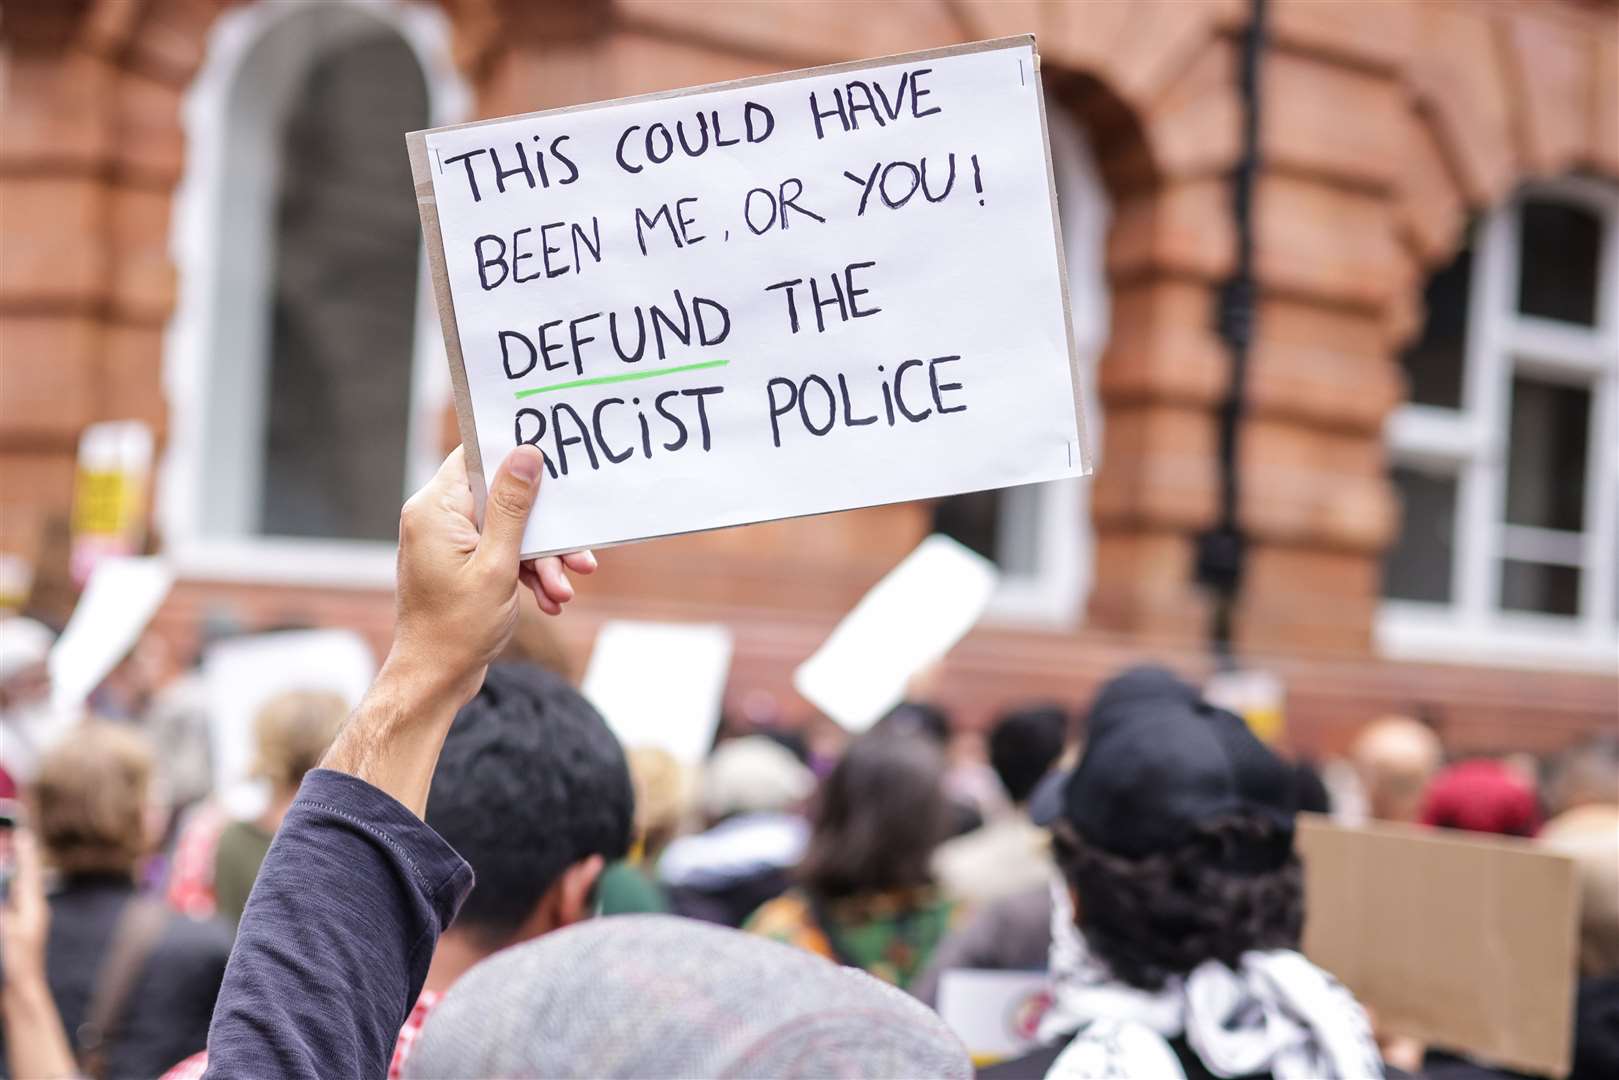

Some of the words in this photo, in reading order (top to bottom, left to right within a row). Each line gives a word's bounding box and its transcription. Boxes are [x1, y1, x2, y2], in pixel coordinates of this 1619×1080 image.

[615, 101, 775, 174] COULD
[809, 68, 942, 140] HAVE
[474, 216, 601, 291] BEEN
[744, 178, 826, 236] OR
[498, 289, 731, 380] DEFUND
[764, 261, 882, 334] THE
